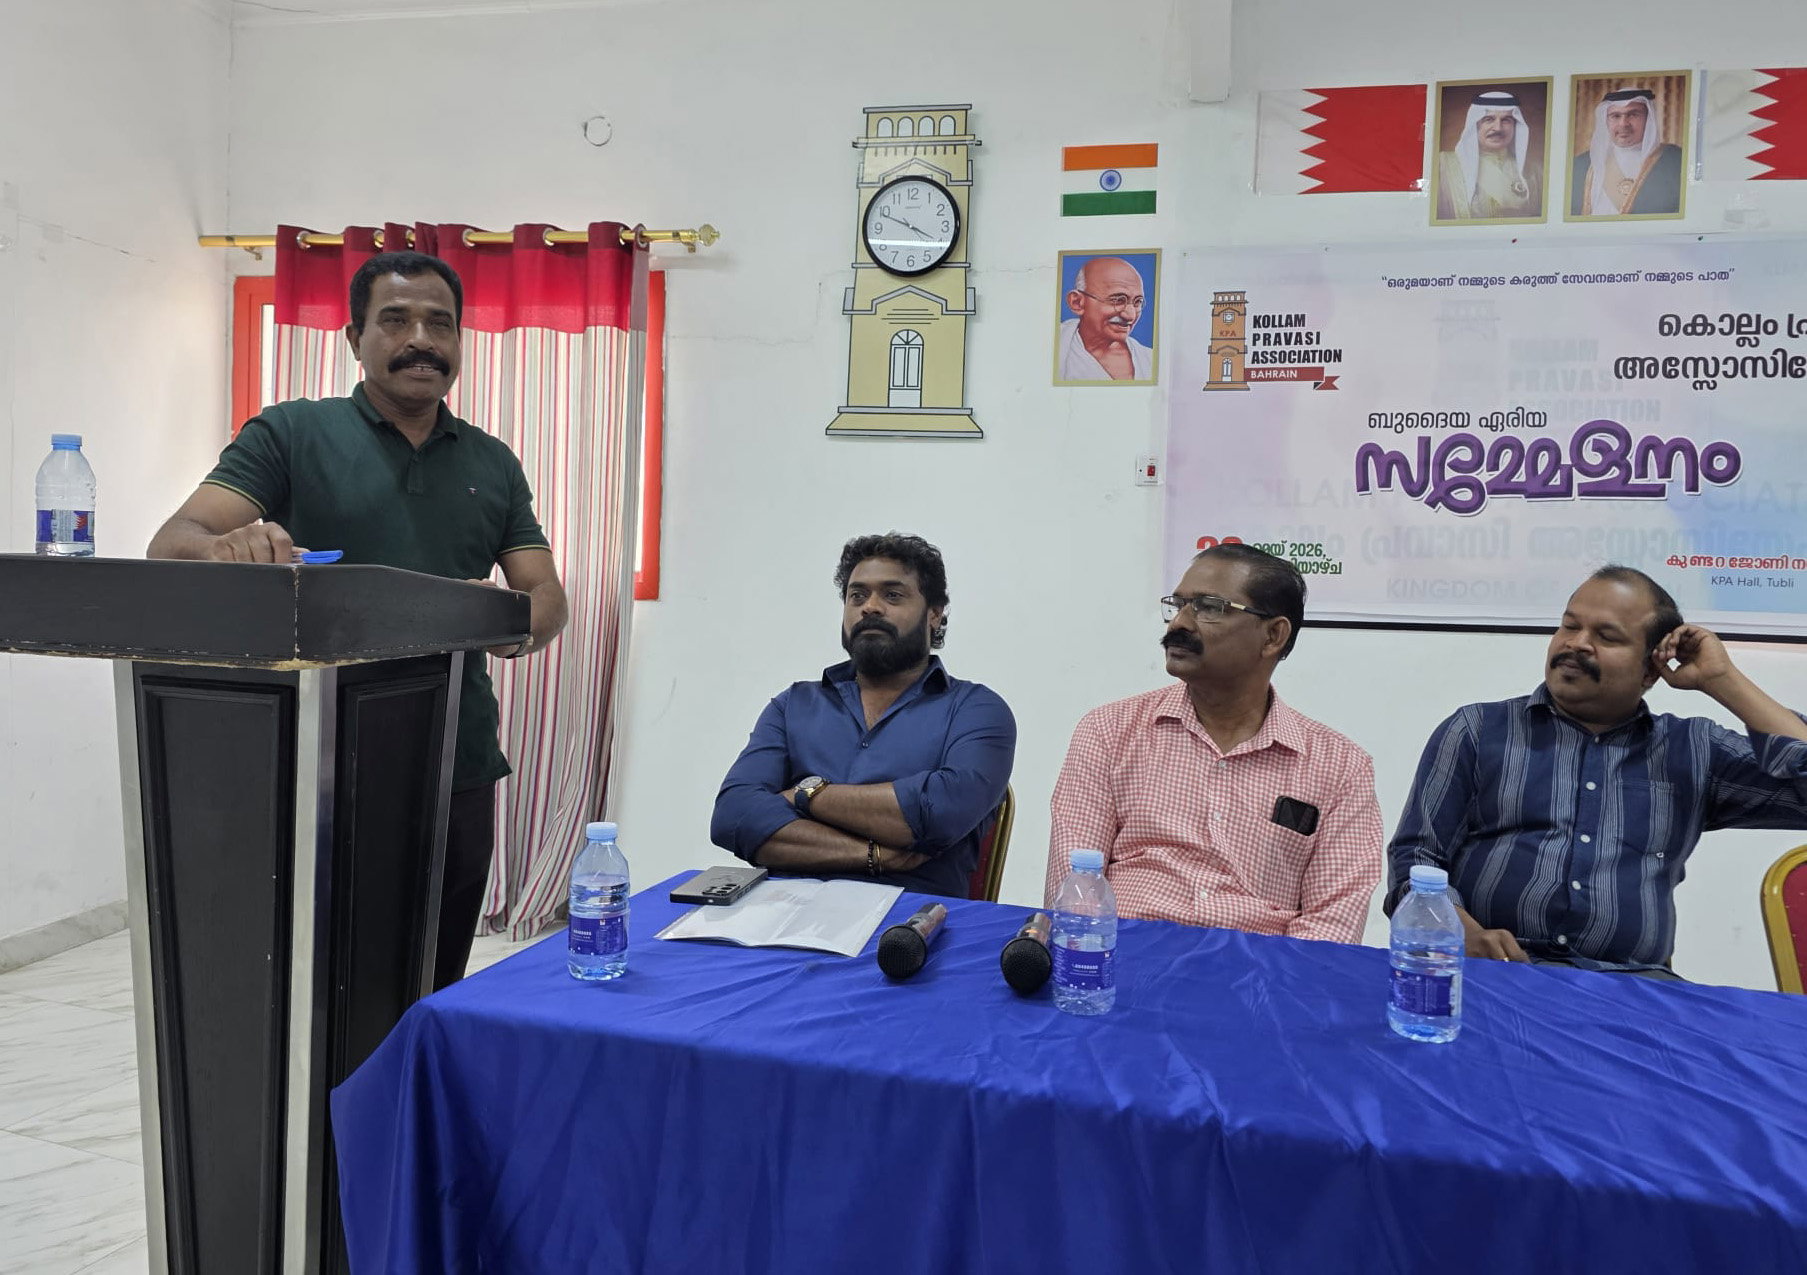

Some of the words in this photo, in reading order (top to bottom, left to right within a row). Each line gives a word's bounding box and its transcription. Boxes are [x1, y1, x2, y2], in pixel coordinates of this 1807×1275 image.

[907, 188, 920, 200] 12
[936, 204, 945, 216] 2
[874, 222, 883, 235] 9
[941, 220, 950, 233] 3
[891, 251, 899, 263] 7
[907, 255, 915, 267] 6
[923, 250, 931, 262] 5
[1458, 276, 1505, 289] നമ്മുടെ
[1644, 271, 1693, 284] നമ്മുടെ
[1253, 314, 1306, 329] KOLLAM
[1658, 313, 1778, 348] കൊല്ലം
[1252, 331, 1321, 347] PRAVASI
[1251, 349, 1342, 365] ASSOCIATION
[1250, 369, 1298, 379] BAHRAIN
[1368, 412, 1471, 434] ബുദൈയ
[1479, 406, 1547, 432] ഏരിയ
[1355, 419, 1742, 515] സമ്മേളനം
[1289, 543, 1326, 559] 2026,
[1711, 576, 1733, 586] KPA
[1738, 577, 1762, 588] Hall,
[1767, 577, 1794, 588] Tubli
